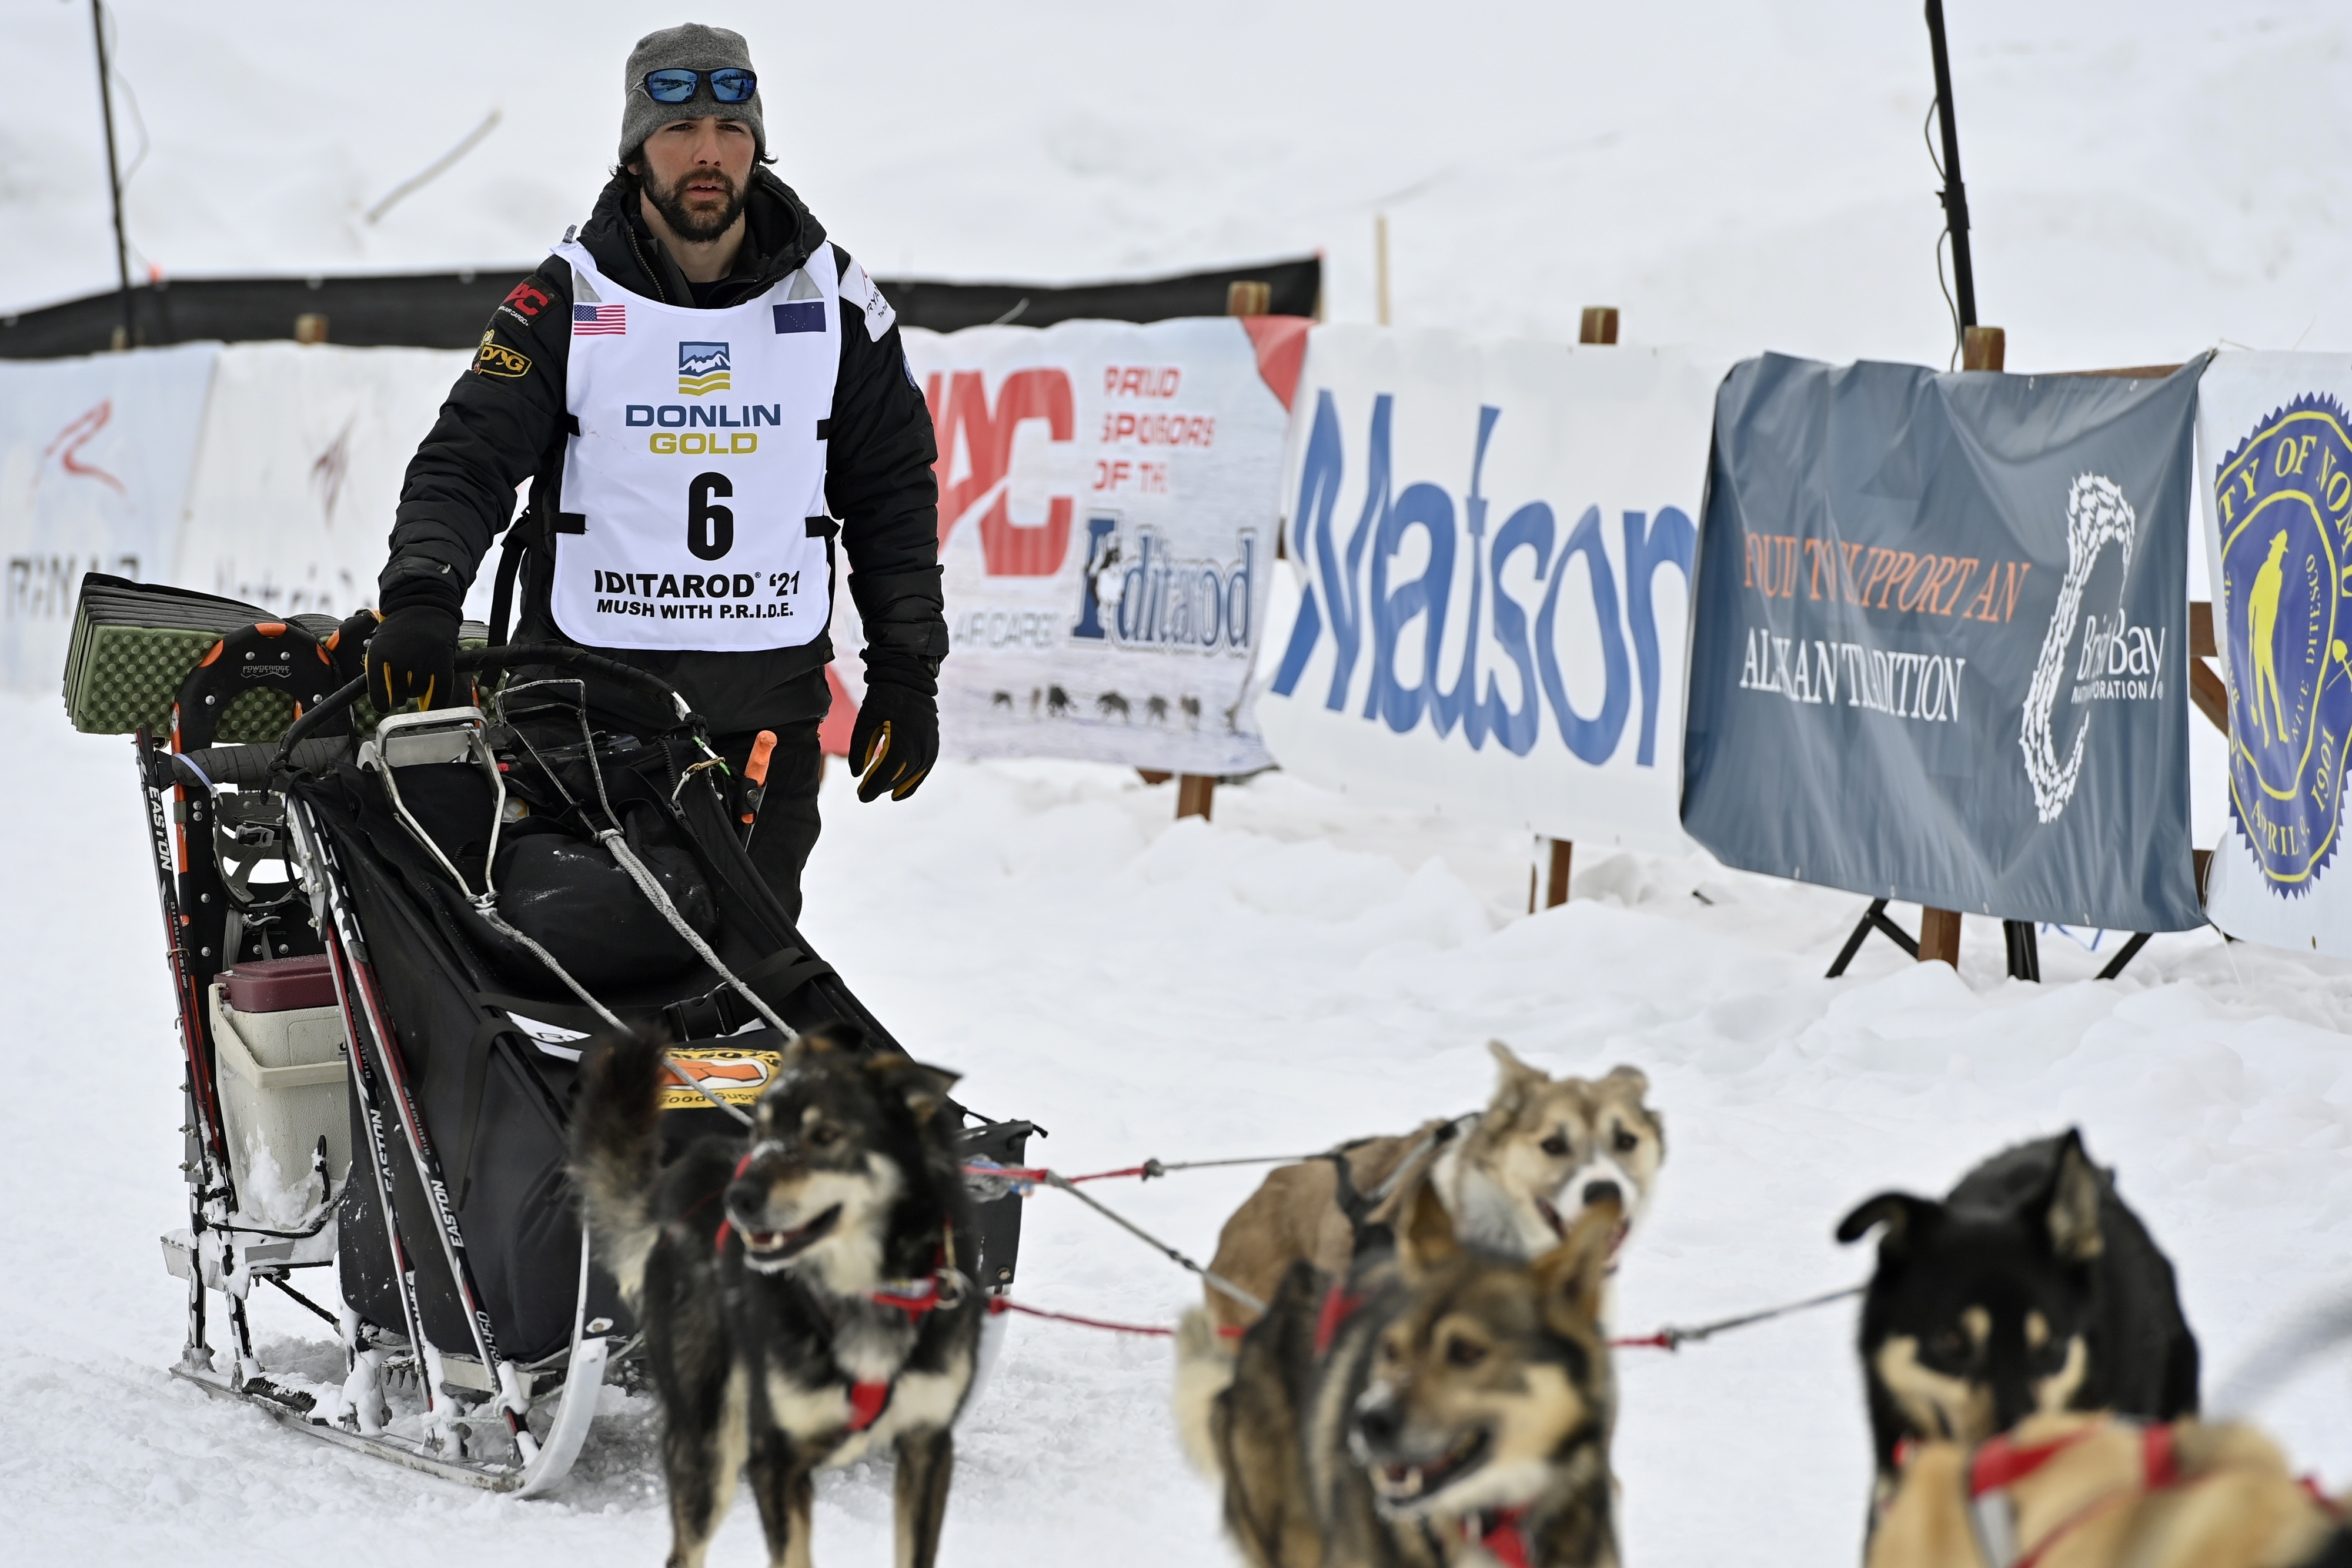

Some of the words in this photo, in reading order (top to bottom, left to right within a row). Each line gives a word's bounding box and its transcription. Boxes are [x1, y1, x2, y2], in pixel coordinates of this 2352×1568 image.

[510, 311, 527, 325] CARGO
[626, 404, 781, 427] DONLIN
[649, 433, 758, 454] GOLD
[2218, 457, 2260, 527] TY
[2274, 434, 2317, 477] OF
[687, 472, 734, 561] 6
[594, 570, 755, 599] IDITAROD
[597, 599, 655, 618] MUSH
[660, 604, 713, 619] WITH
[720, 602, 794, 619] P.R.I.D.E.
[1271, 387, 1698, 767] Matson
[1962, 560, 2032, 624] AN
[2305, 553, 2322, 664] DITESCO
[243, 665, 290, 674] POWDERIDGE
[2108, 607, 2166, 700] Bay
[2311, 724, 2335, 812] 1901
[148, 785, 172, 871] EASTON
[370, 1109, 393, 1192] EASTON
[431, 1179, 465, 1248] EASTON
[476, 1310, 495, 1343] 450
